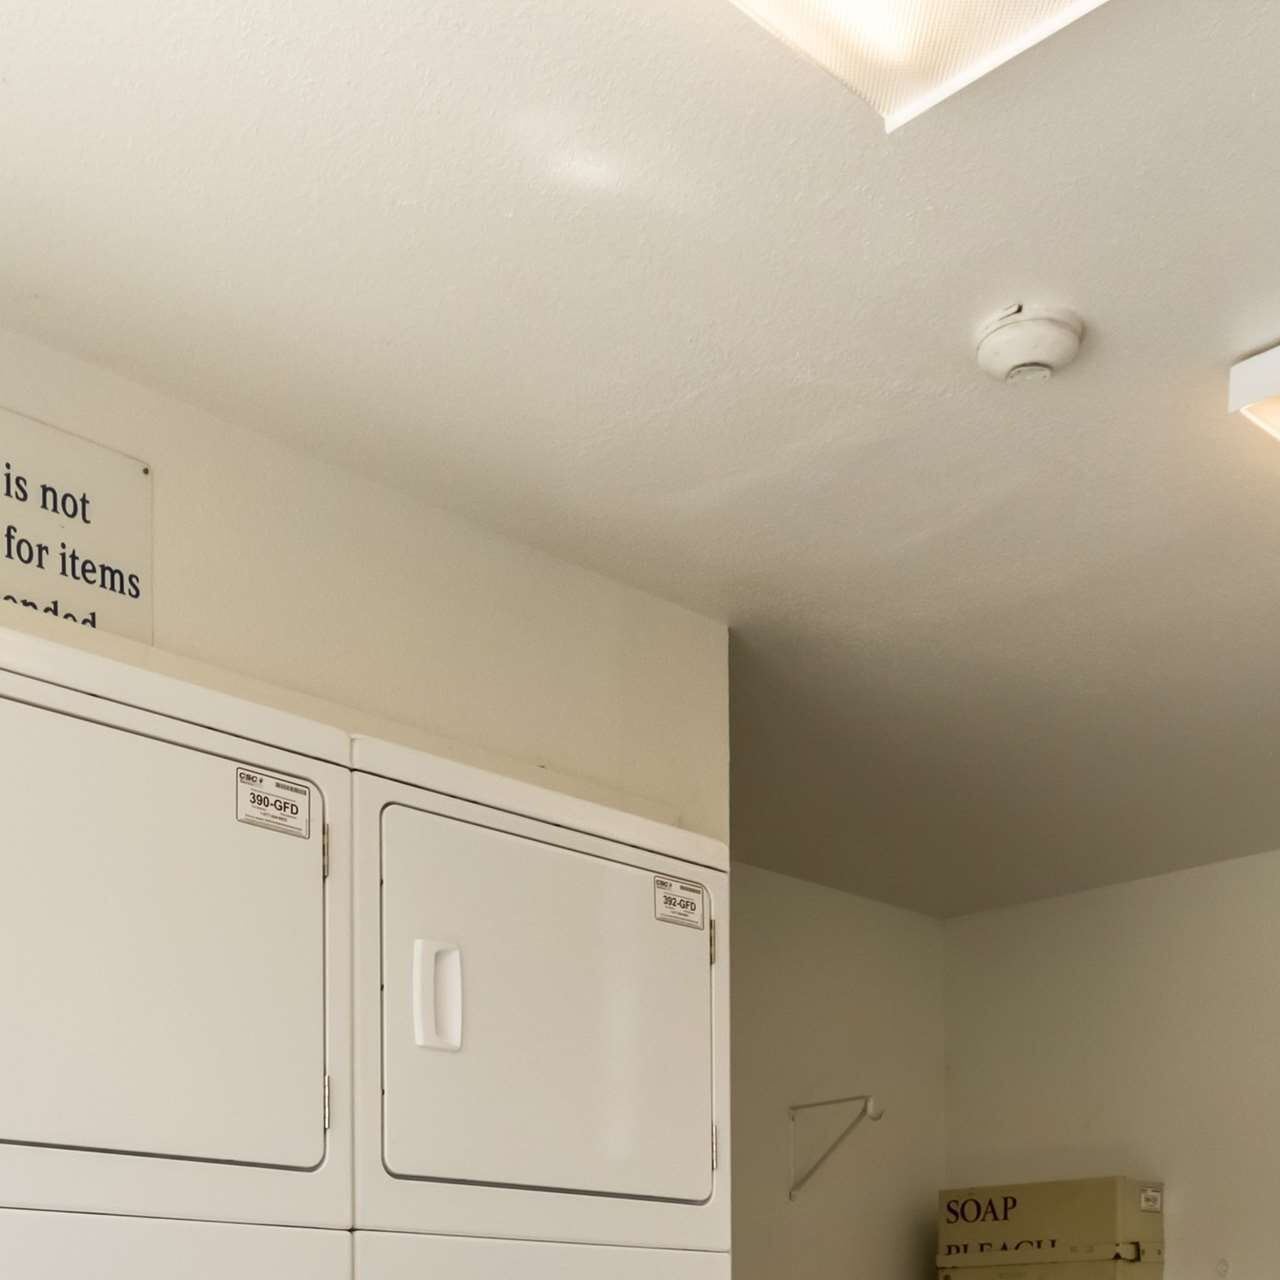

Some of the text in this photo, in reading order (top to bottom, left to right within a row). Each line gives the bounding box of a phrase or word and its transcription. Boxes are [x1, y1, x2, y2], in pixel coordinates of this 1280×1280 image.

[3, 462, 28, 502] is
[39, 481, 92, 525] not
[4, 525, 50, 569] for
[59, 542, 141, 600] items
[249, 791, 299, 815] 390-GFD
[945, 1195, 1017, 1224] SOAP
